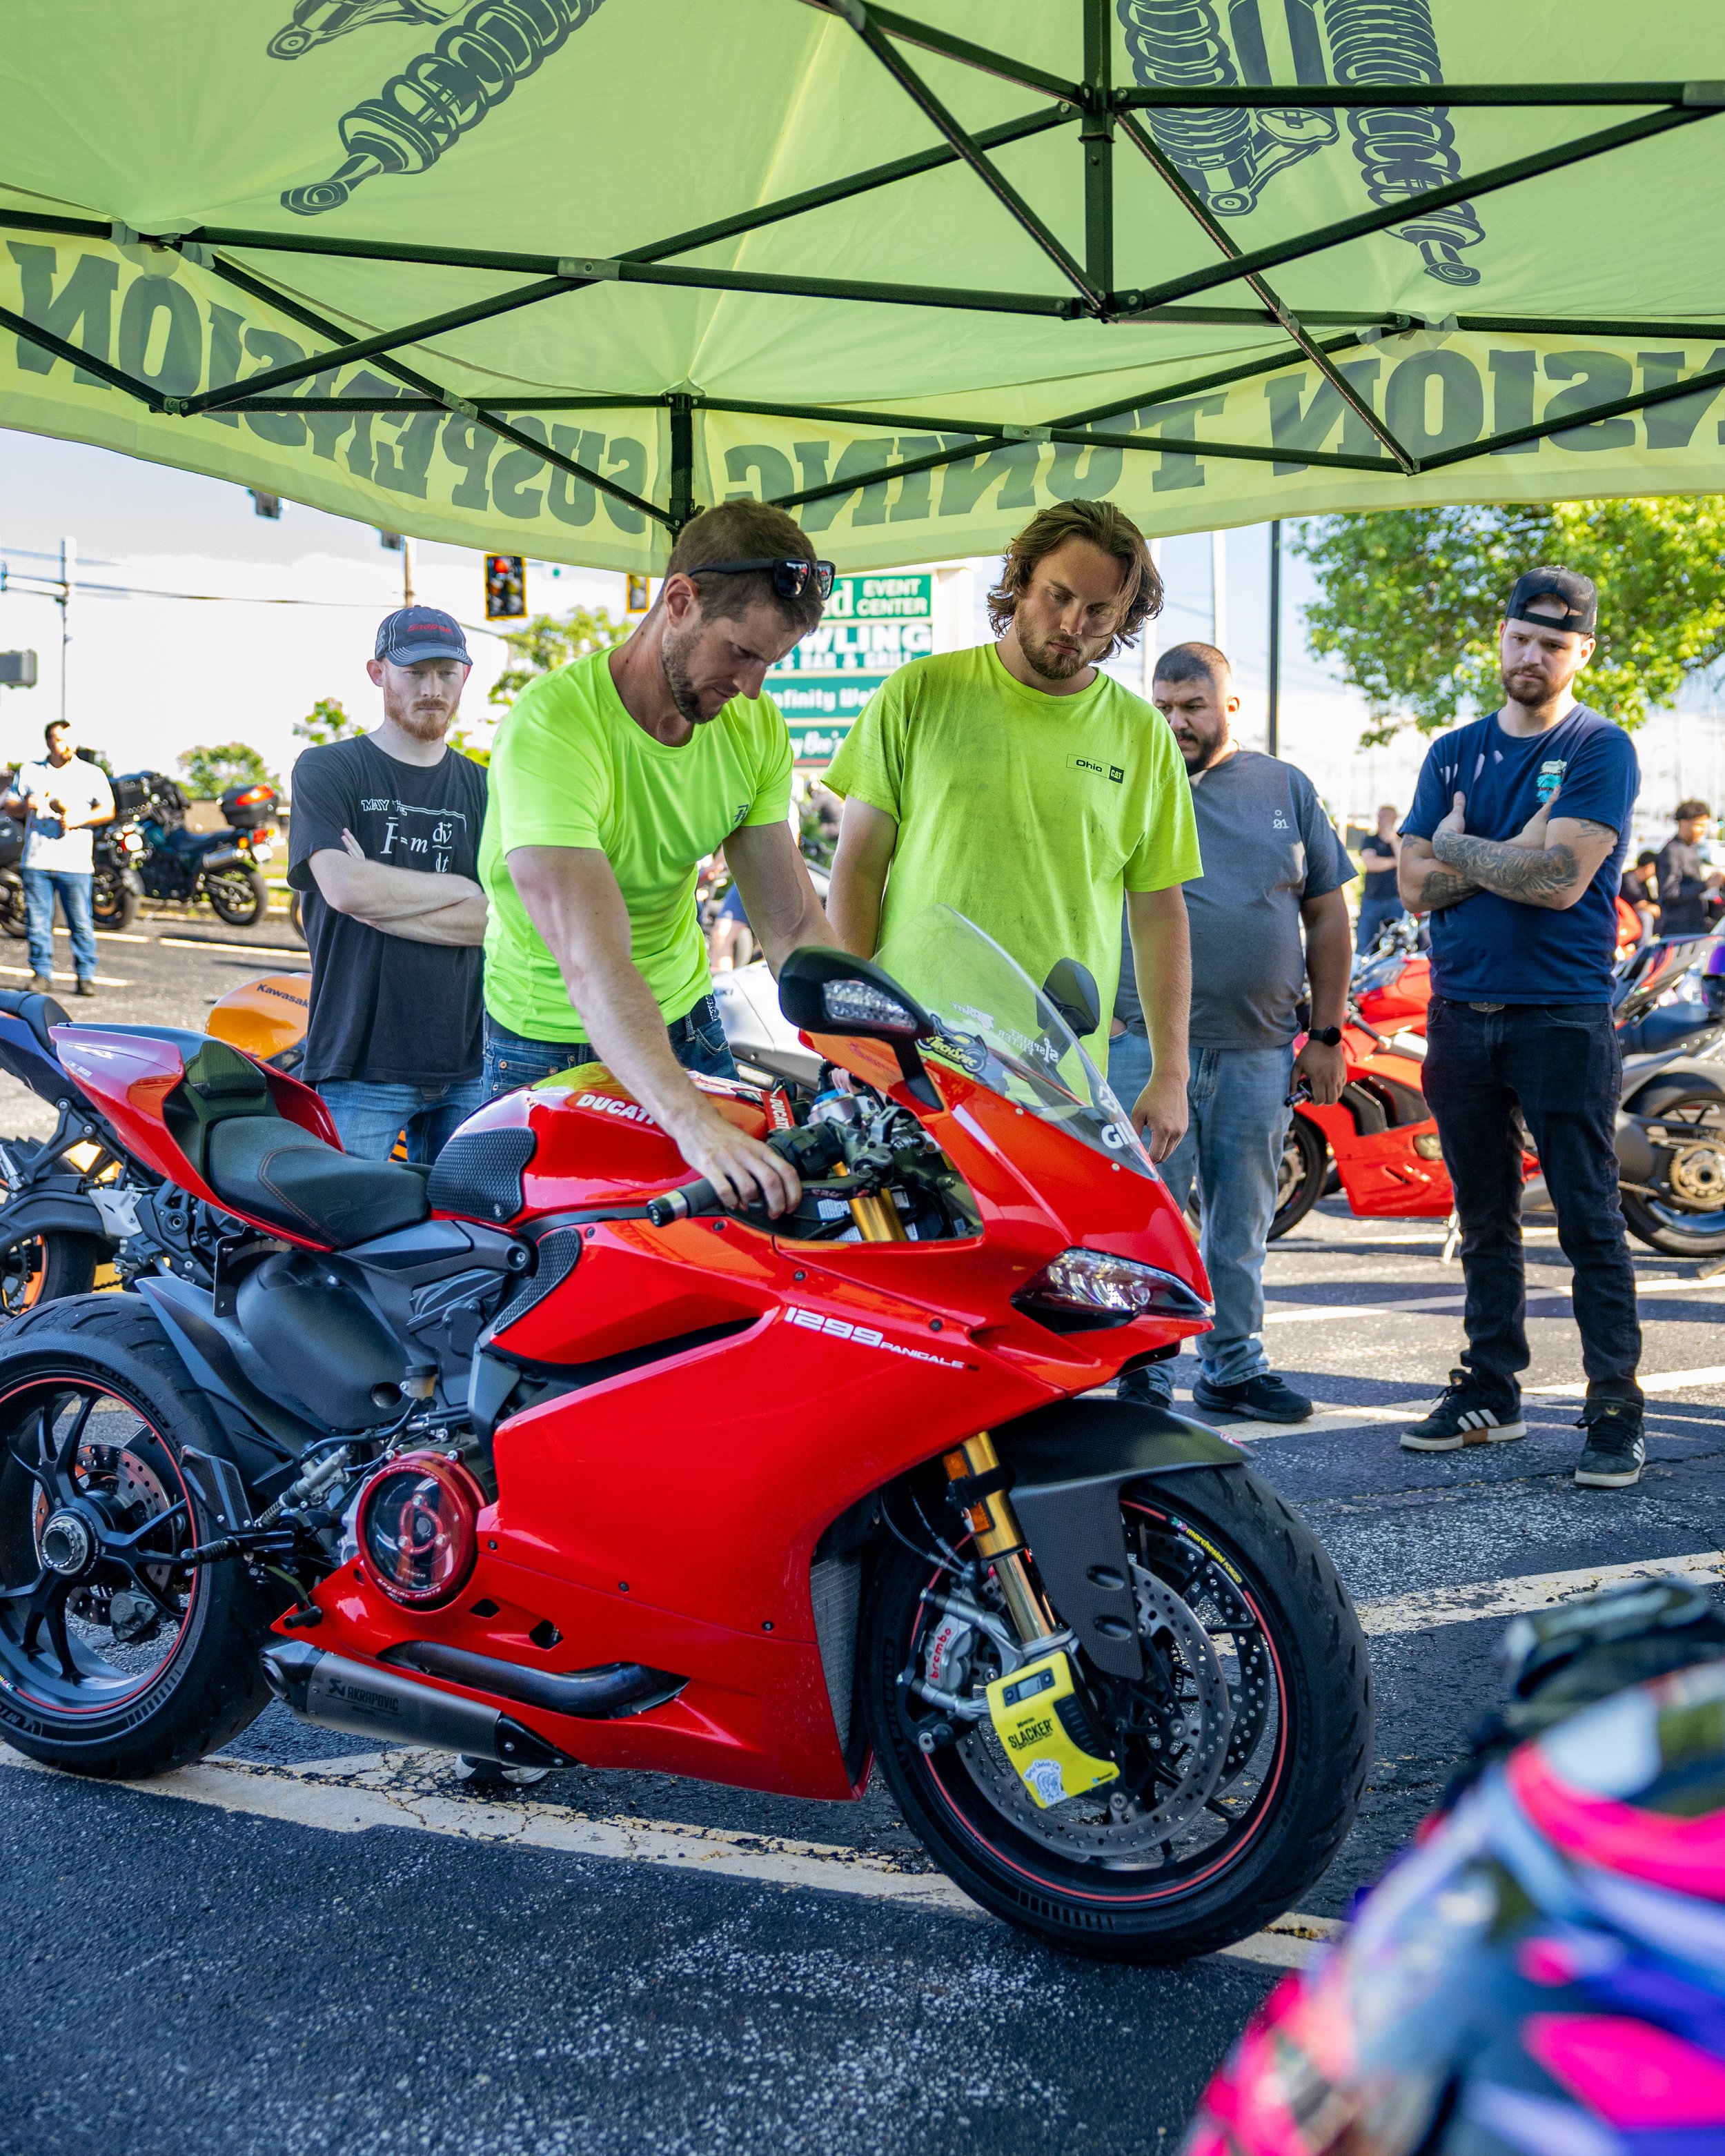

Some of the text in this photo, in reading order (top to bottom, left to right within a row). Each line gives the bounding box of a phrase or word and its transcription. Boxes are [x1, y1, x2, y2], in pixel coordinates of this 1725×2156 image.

[862, 578, 922, 597] EVENT
[856, 597, 928, 616] CENTER
[797, 624, 931, 653] WLING
[764, 689, 836, 712] nfinity
[1076, 759, 1123, 780] Ohio CAT
[361, 798, 390, 811] MAY
[257, 983, 308, 1008] Kawasak
[784, 1306, 965, 1369] 1299 PANIGALE
[929, 1628, 952, 1680] brembo
[1007, 1719, 1054, 1749] SLACKER
